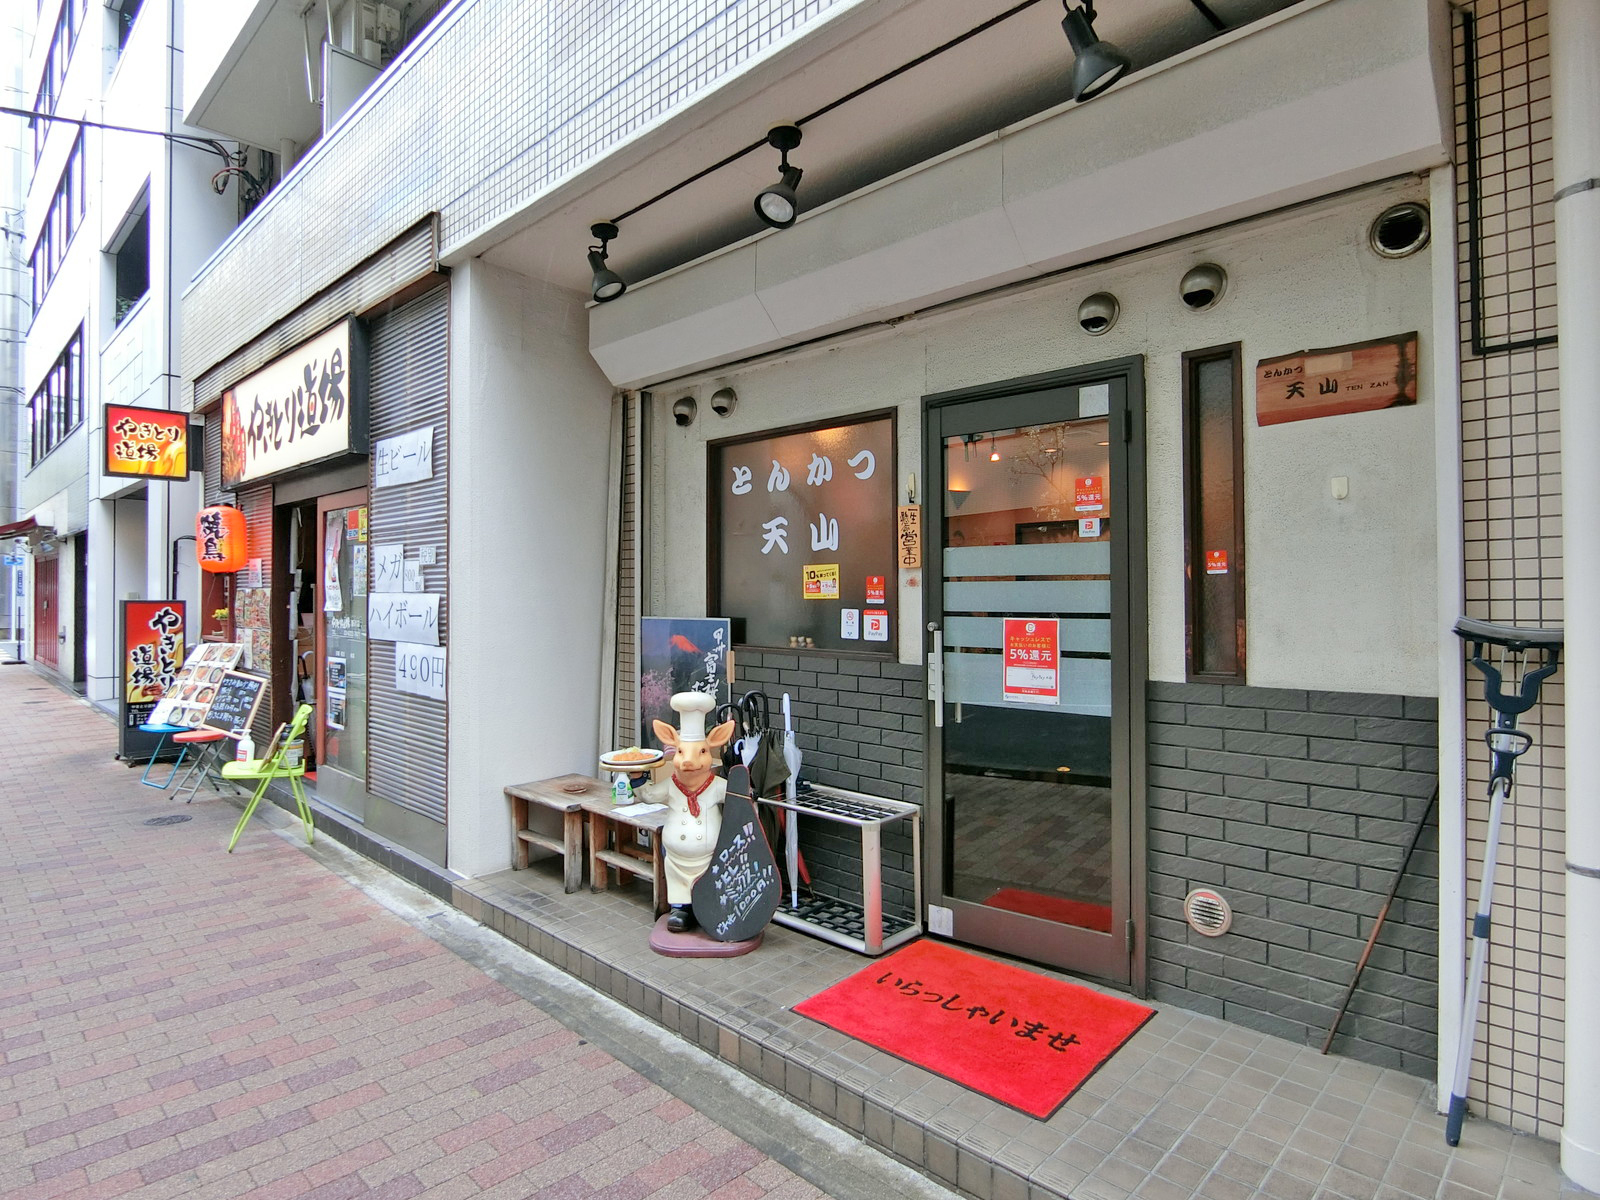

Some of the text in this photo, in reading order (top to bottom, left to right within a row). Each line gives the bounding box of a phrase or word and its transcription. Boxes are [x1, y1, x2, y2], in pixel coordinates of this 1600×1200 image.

[1263, 366, 1303, 379] とんかつ
[1285, 377, 1389, 400] 天山 TEN ZAN
[247, 347, 346, 461] やきとり道場
[114, 417, 180, 442] やきとり
[114, 441, 160, 461] 道場
[377, 441, 432, 476] 生ビール
[731, 449, 876, 495] とんかつ
[760, 512, 840, 555] 天山
[377, 552, 403, 582] メガ
[369, 600, 437, 630] ハイボール
[130, 644, 157, 686] 道場
[398, 654, 445, 688] 490円
[1009, 648, 1052, 662] 5%還元
[876, 972, 1081, 1053] いらっしゃいませ
